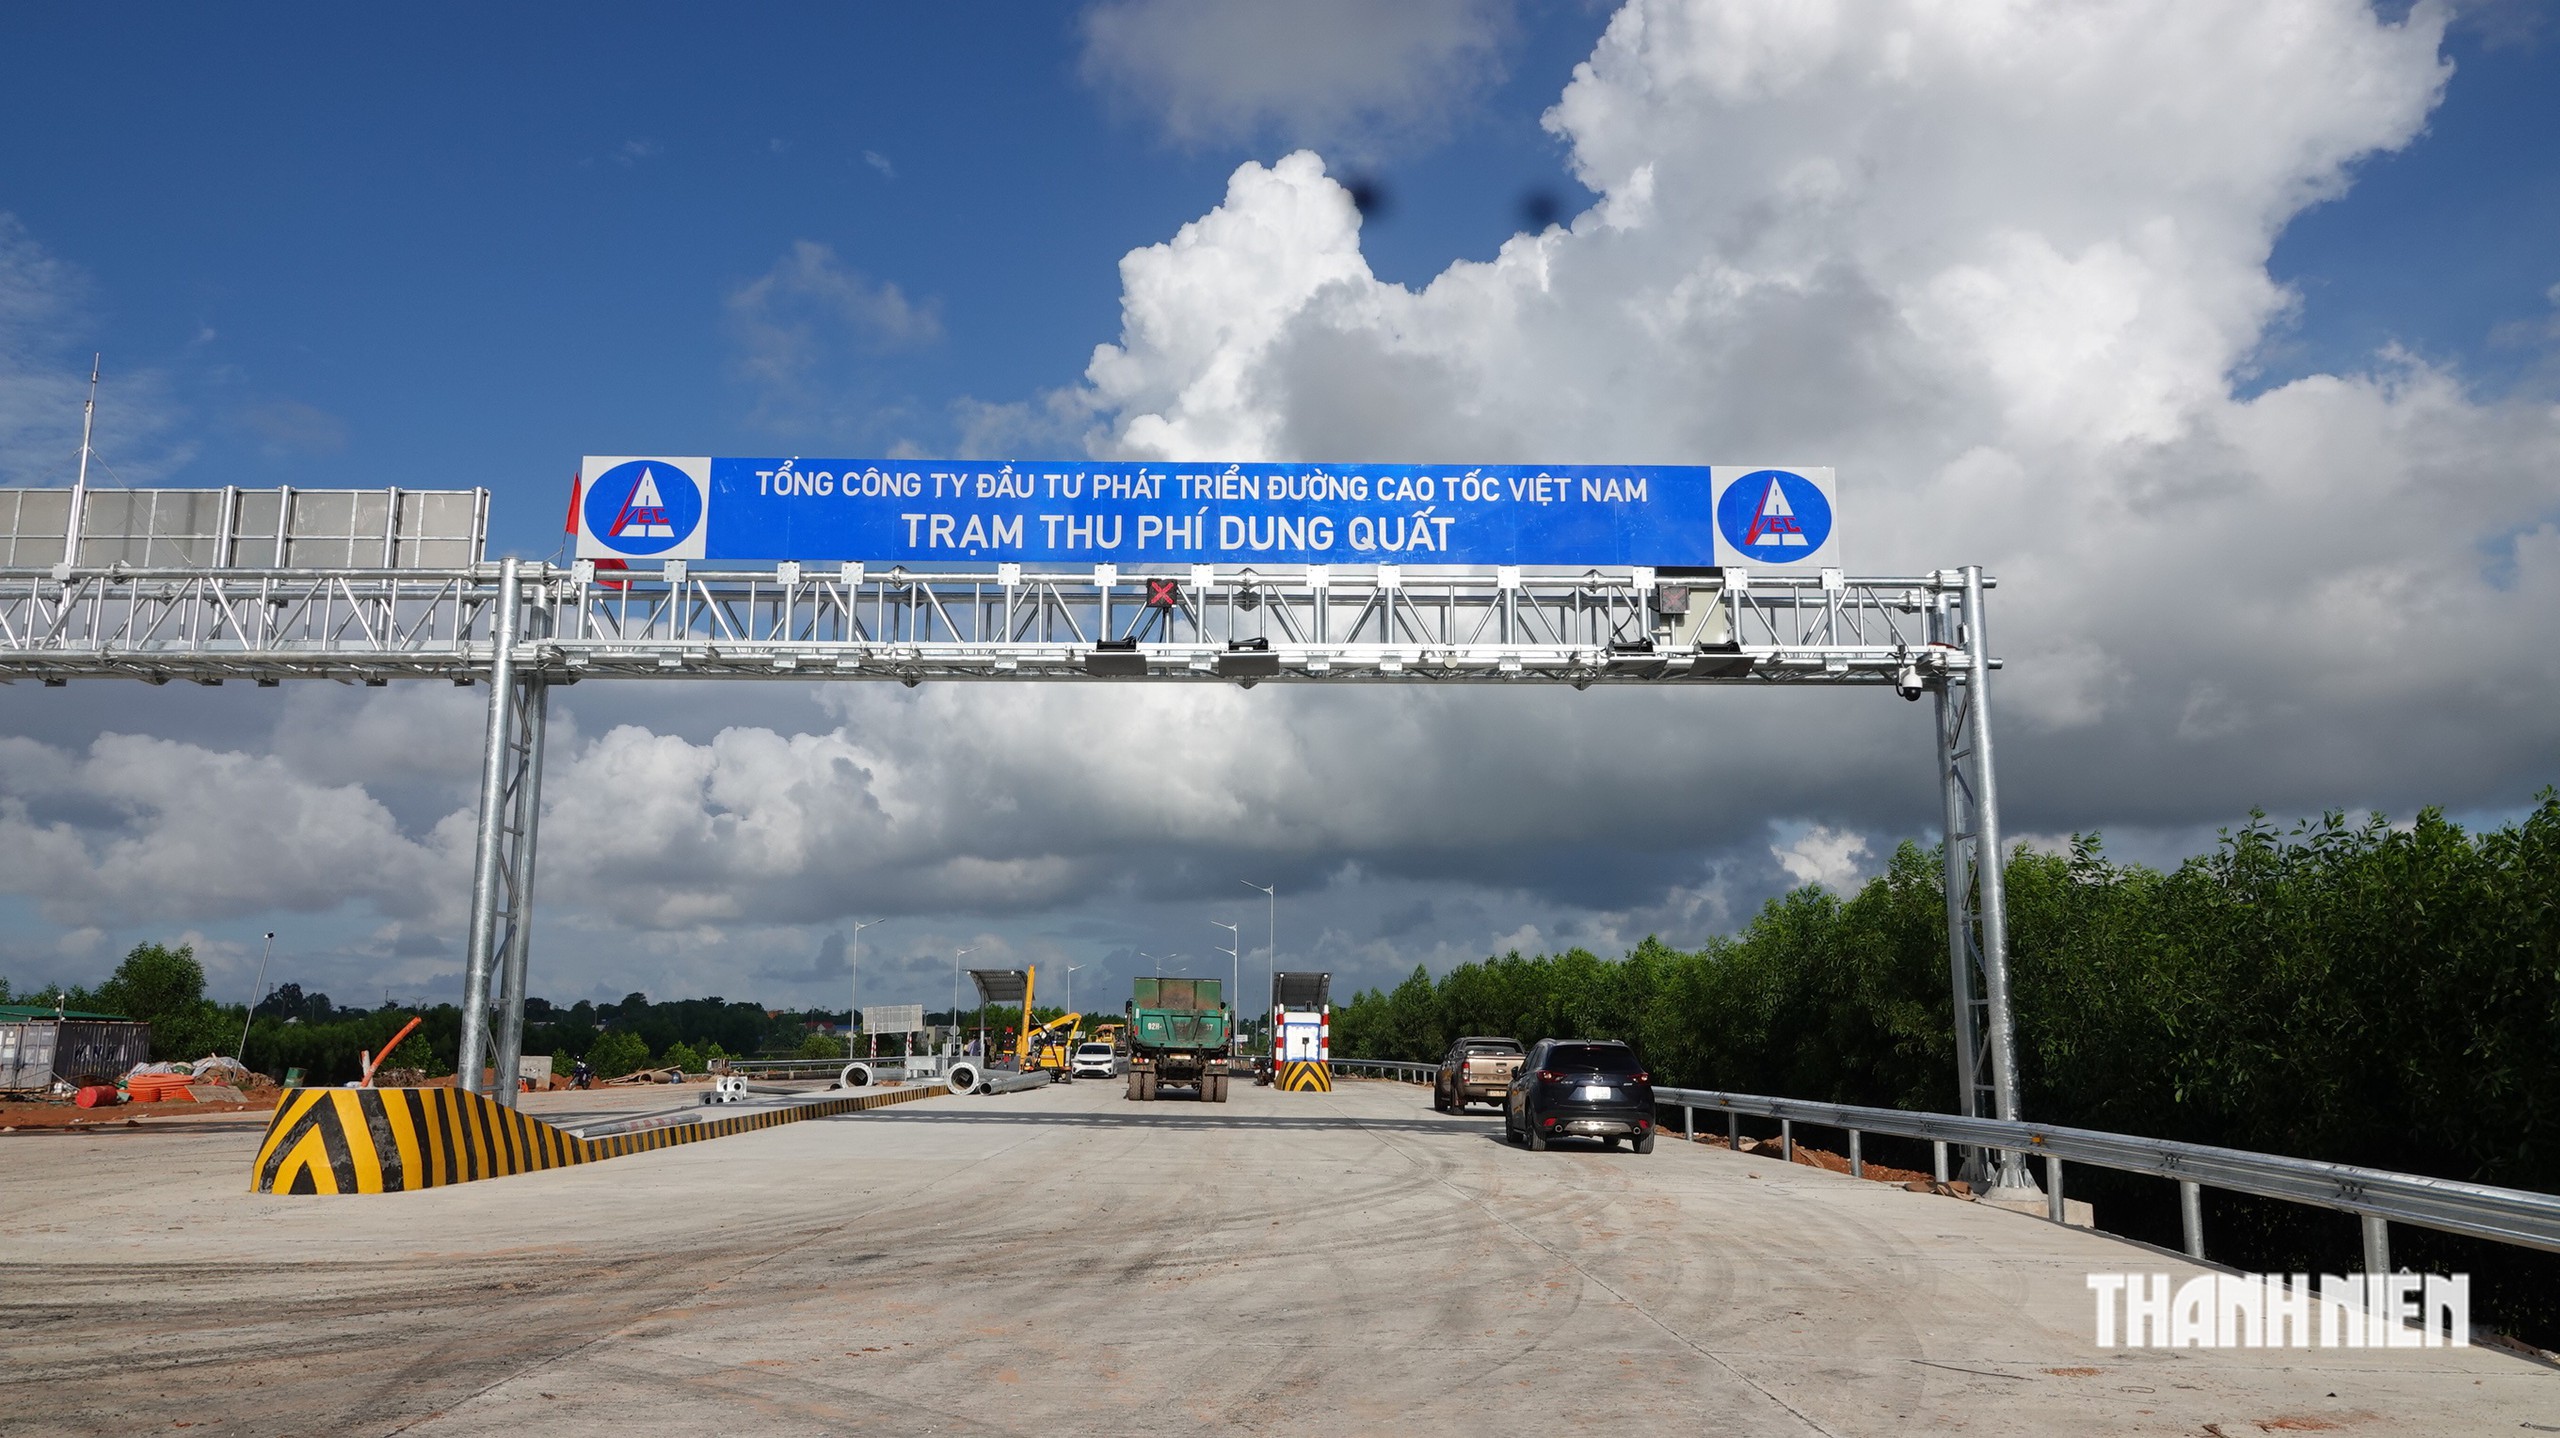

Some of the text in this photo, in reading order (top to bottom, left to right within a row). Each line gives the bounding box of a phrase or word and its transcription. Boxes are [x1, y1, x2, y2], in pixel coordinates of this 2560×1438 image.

[755, 460, 1648, 506] TỔNG CÔNG TY ĐẦU TƯ PHÁT TRIỂN ĐƯỜNG CAO TỐC VIỆT NAM
[901, 505, 1456, 556] TRẠM THU PHÍ DUNG QUẤT
